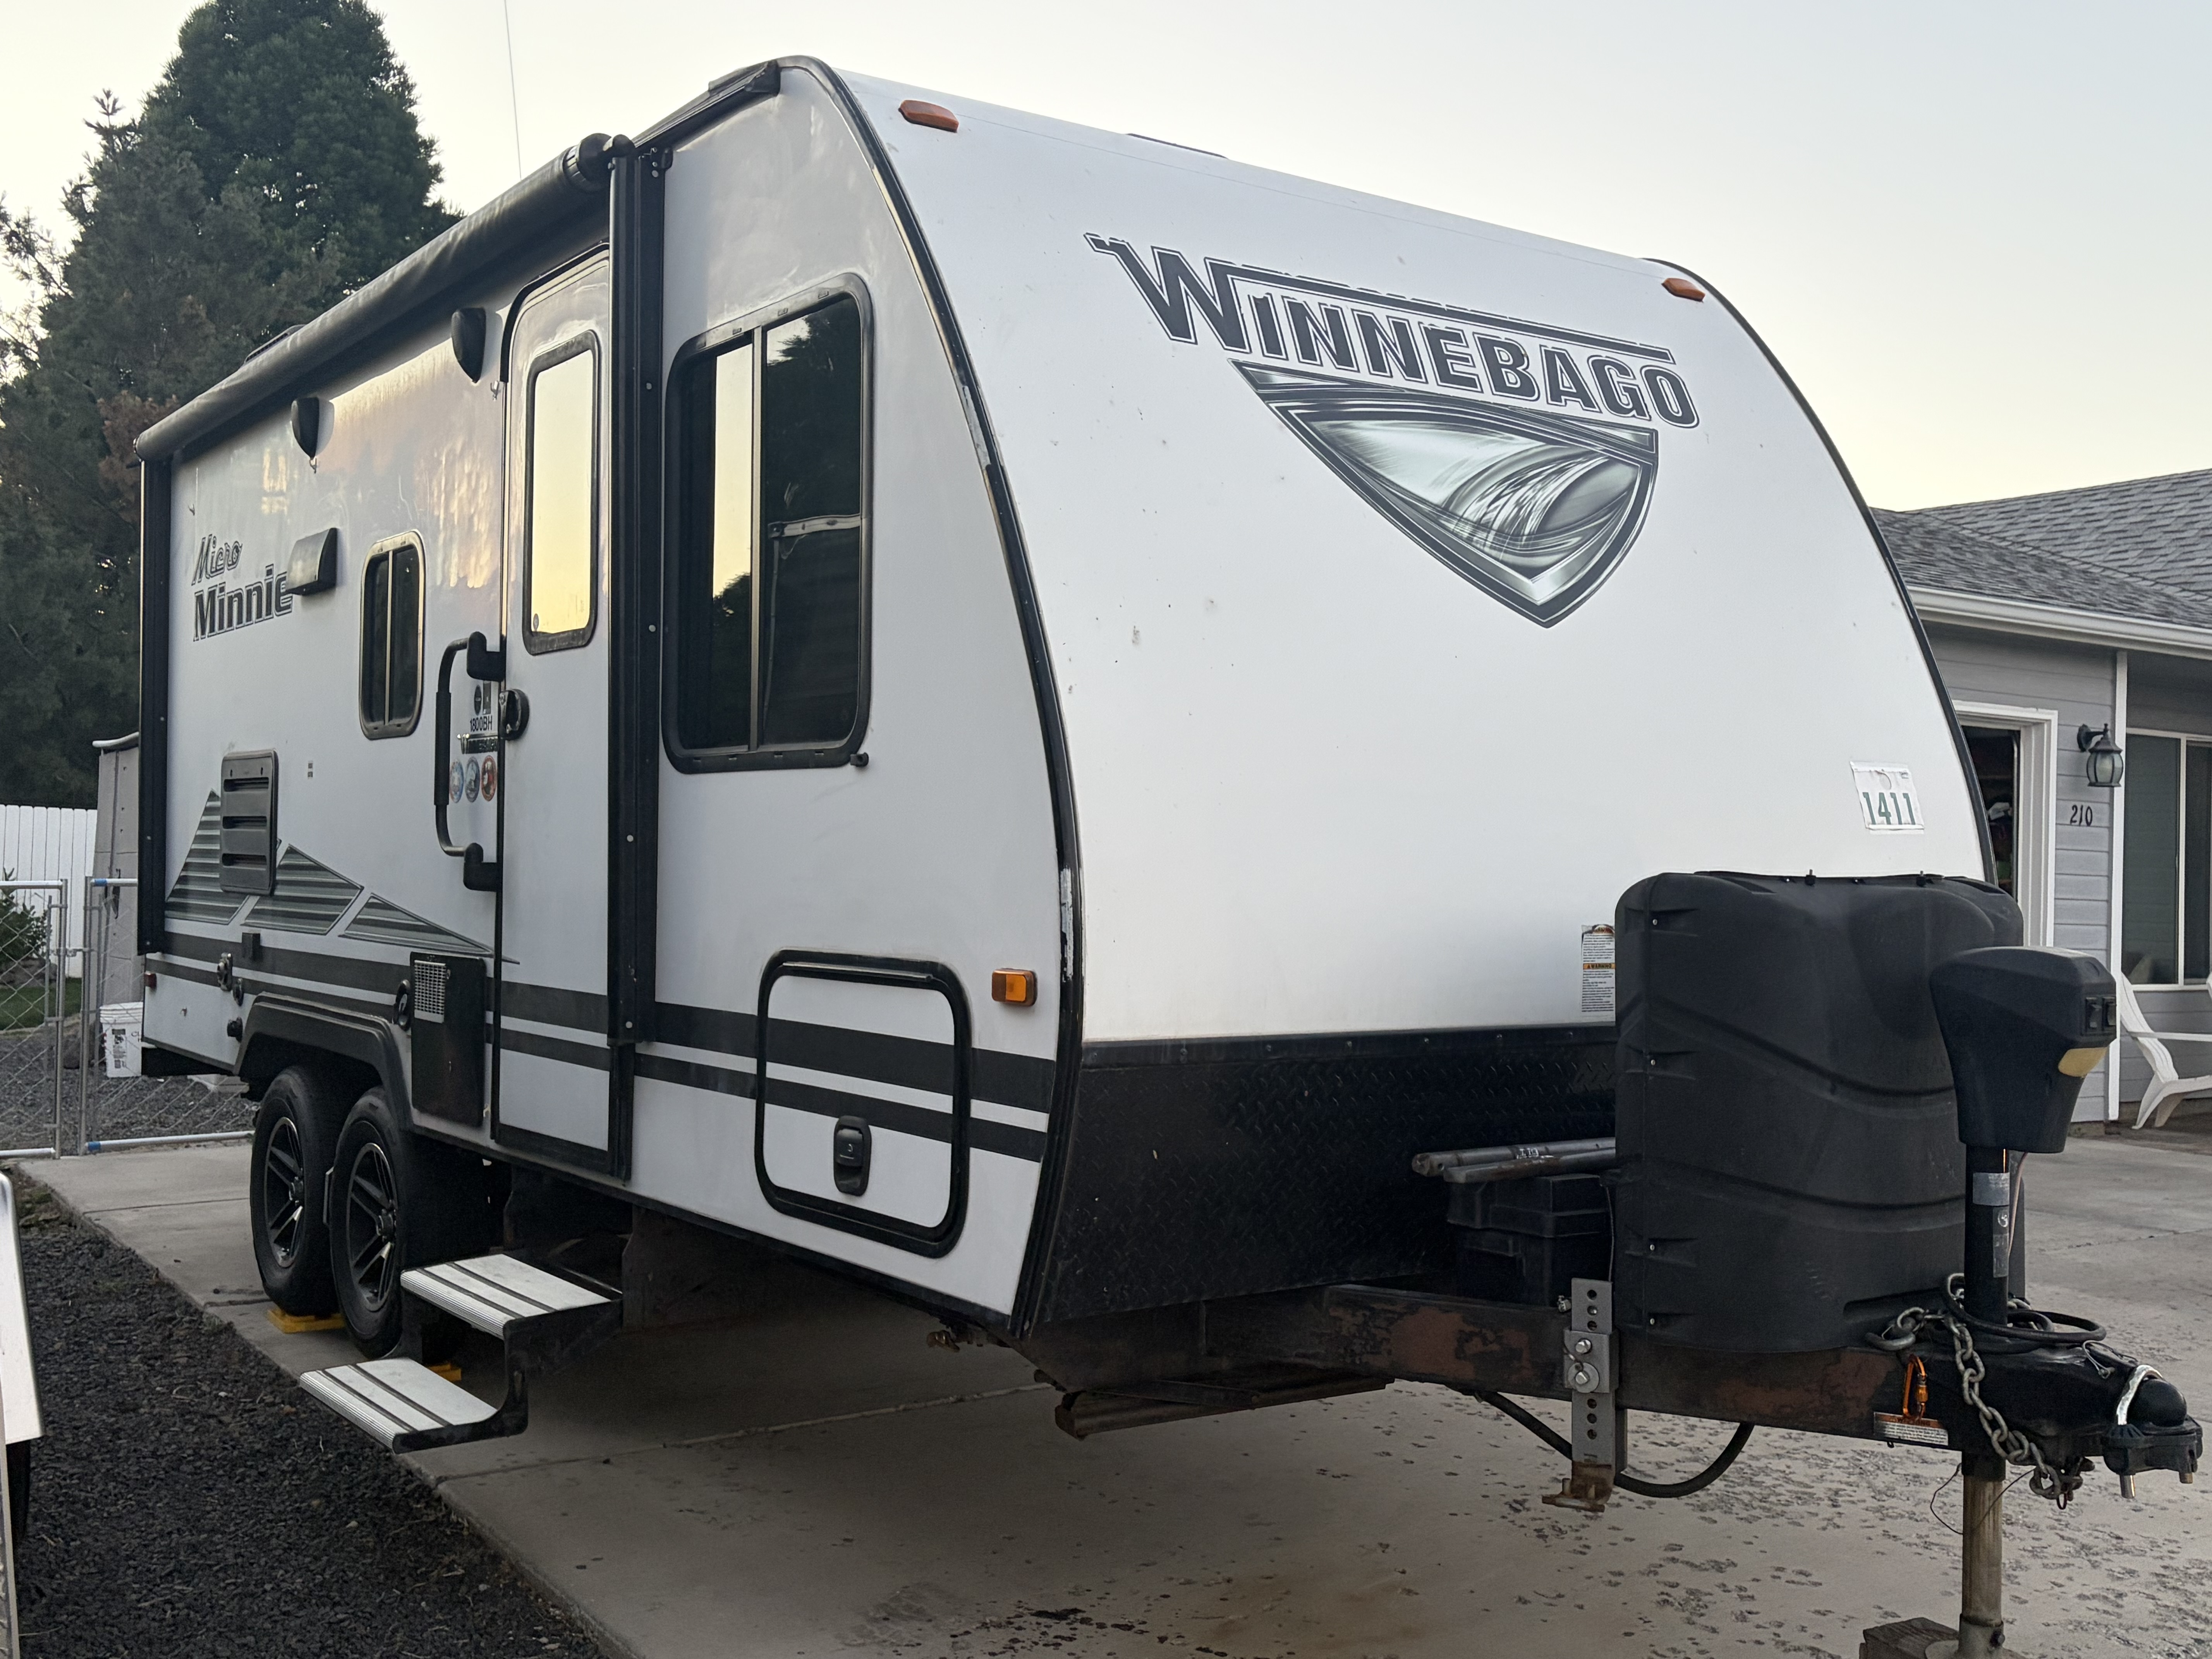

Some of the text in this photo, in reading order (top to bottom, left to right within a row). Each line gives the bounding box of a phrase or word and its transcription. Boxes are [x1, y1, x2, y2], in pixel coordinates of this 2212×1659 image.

[1084, 232, 1700, 428] WINNEBAGO
[191, 534, 243, 586] Micro
[193, 563, 293, 642] Minnie
[1862, 792, 1916, 825] 1411
[2070, 804, 2093, 826] 210
